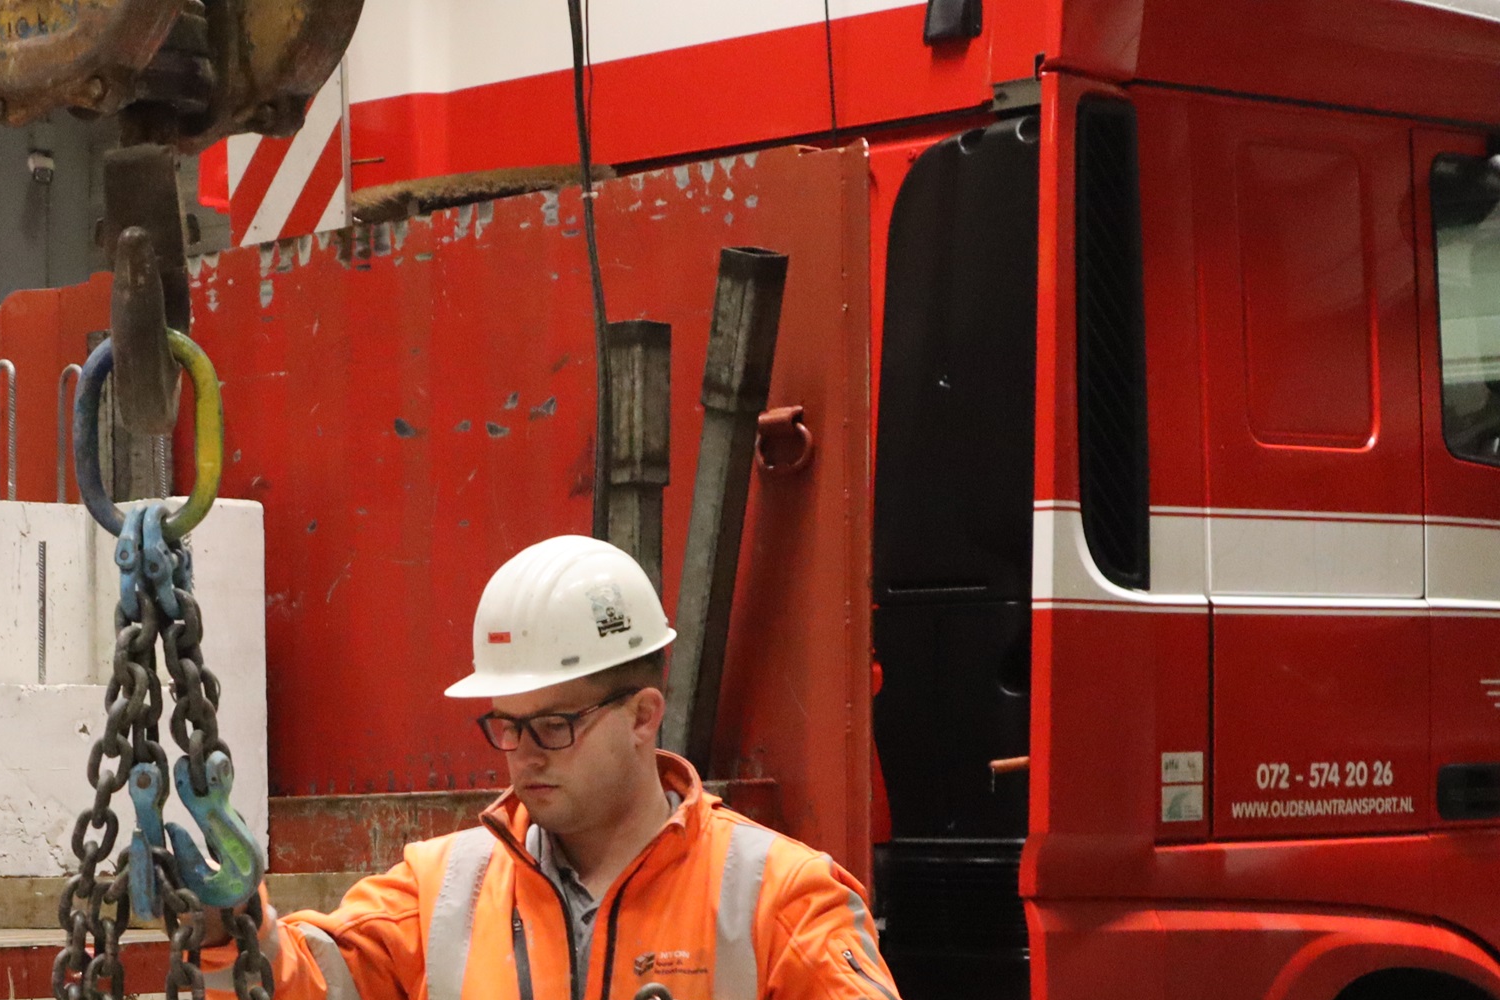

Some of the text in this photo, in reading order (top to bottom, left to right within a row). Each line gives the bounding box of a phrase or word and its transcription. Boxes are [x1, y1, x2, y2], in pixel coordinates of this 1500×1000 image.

[1256, 762, 1290, 789] 072
[1309, 761, 1340, 788] 574
[1345, 760, 1367, 787] 20
[1372, 759, 1393, 786] 26
[1232, 796, 1414, 819] WWW.OUDEMANTRANSPORT.NL
